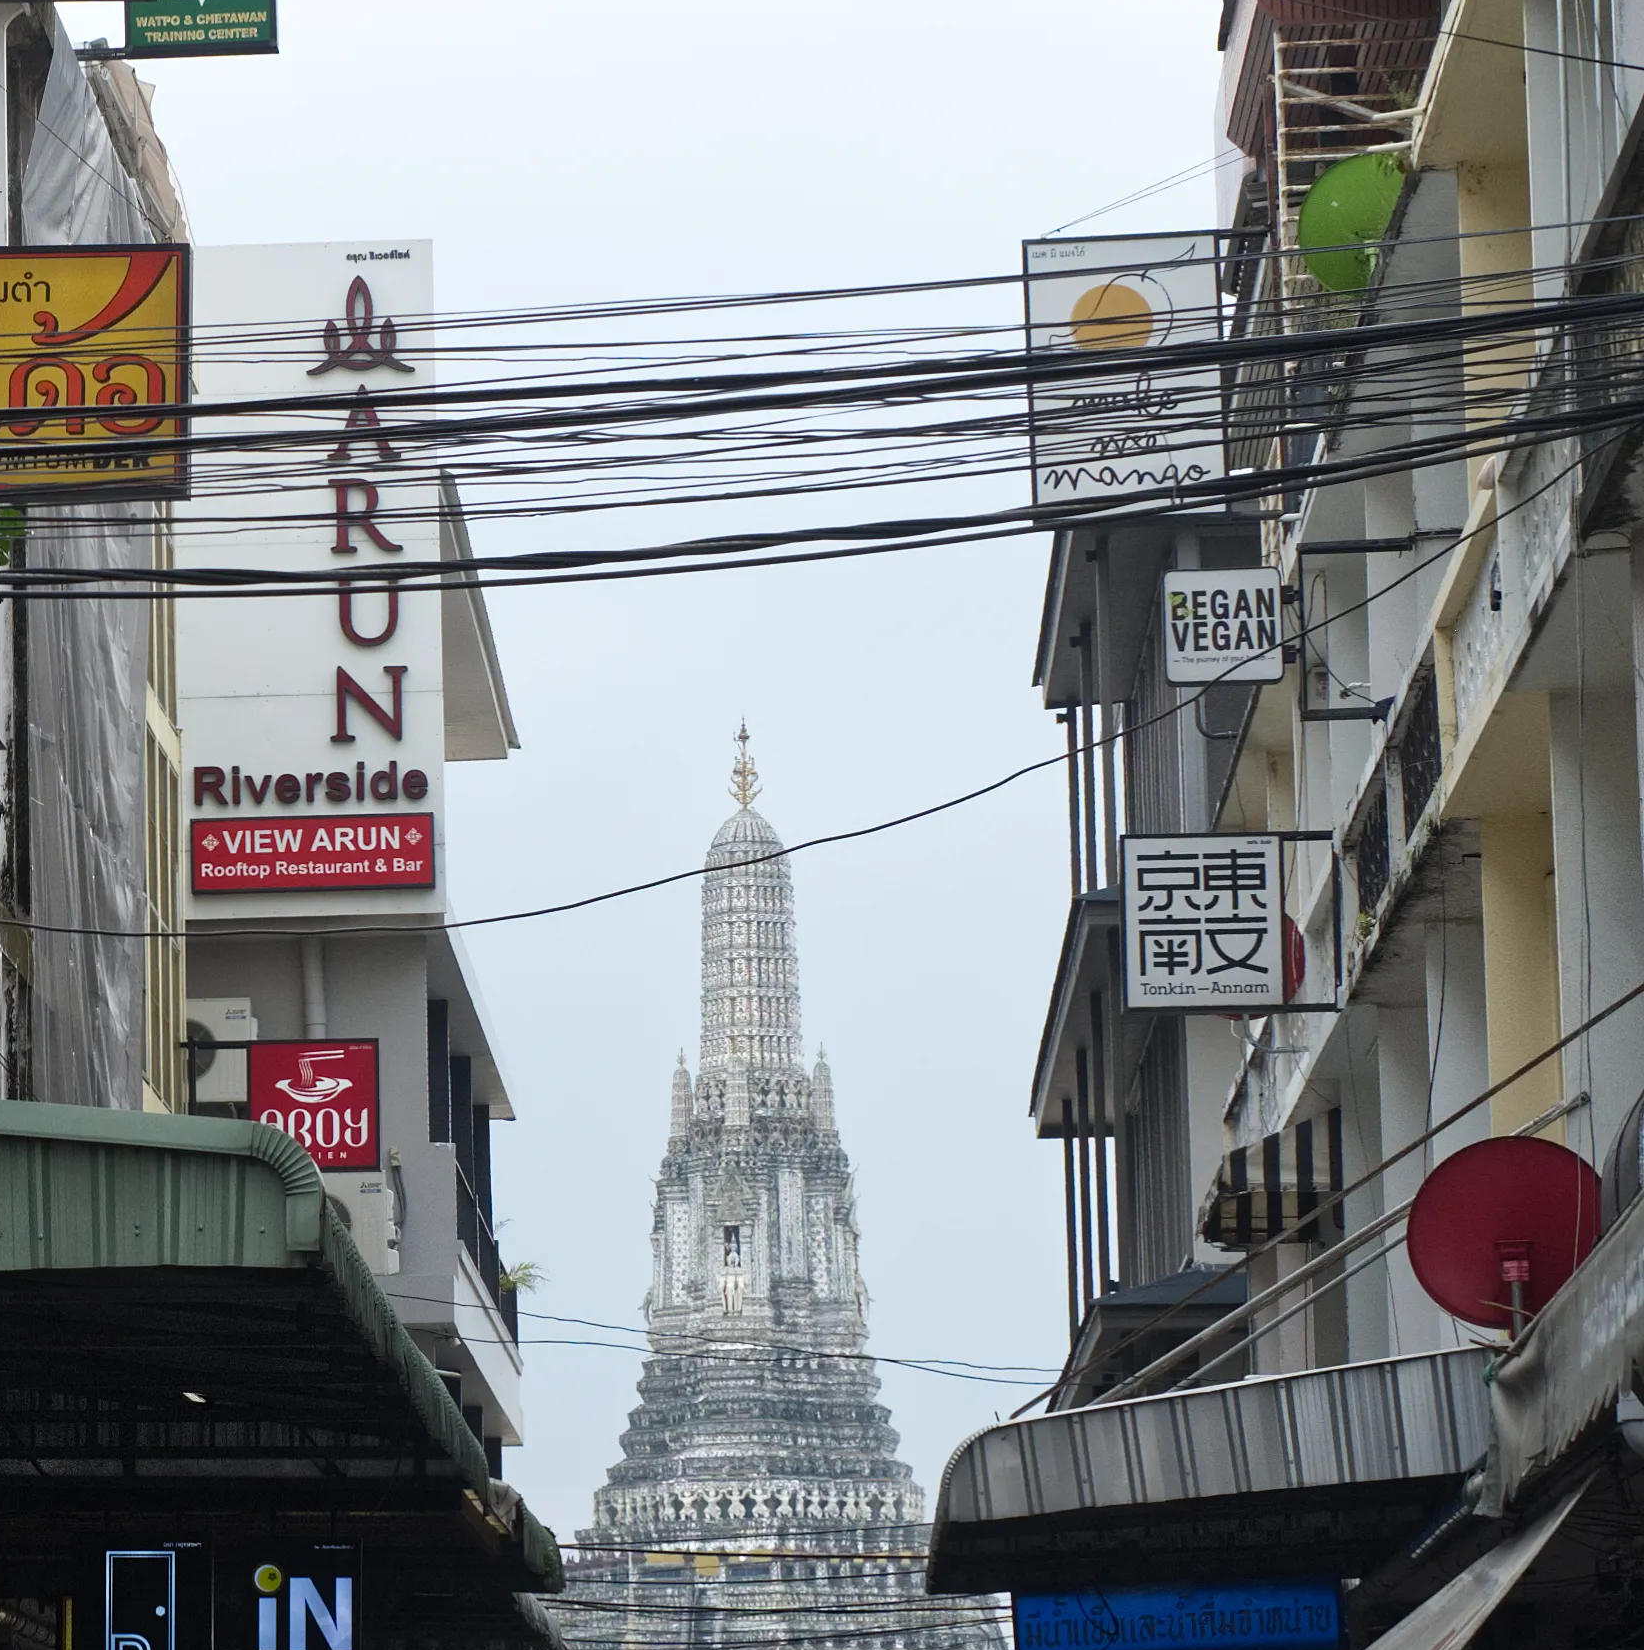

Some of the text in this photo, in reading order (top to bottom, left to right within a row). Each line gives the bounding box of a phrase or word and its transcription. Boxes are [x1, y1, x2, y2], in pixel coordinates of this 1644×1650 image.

[136, 11, 267, 27] WATPO & CHETAWAN
[145, 27, 258, 42] TRAINING CENTER
[1044, 464, 1211, 497] mango
[327, 383, 409, 743] ARUN
[1168, 588, 1275, 621] BEGAN
[1171, 619, 1276, 652] VEGAN
[193, 760, 429, 806] Riverside
[222, 825, 401, 854] VIEW ARUN
[201, 857, 423, 878] Rooftop Restaurant & Bar
